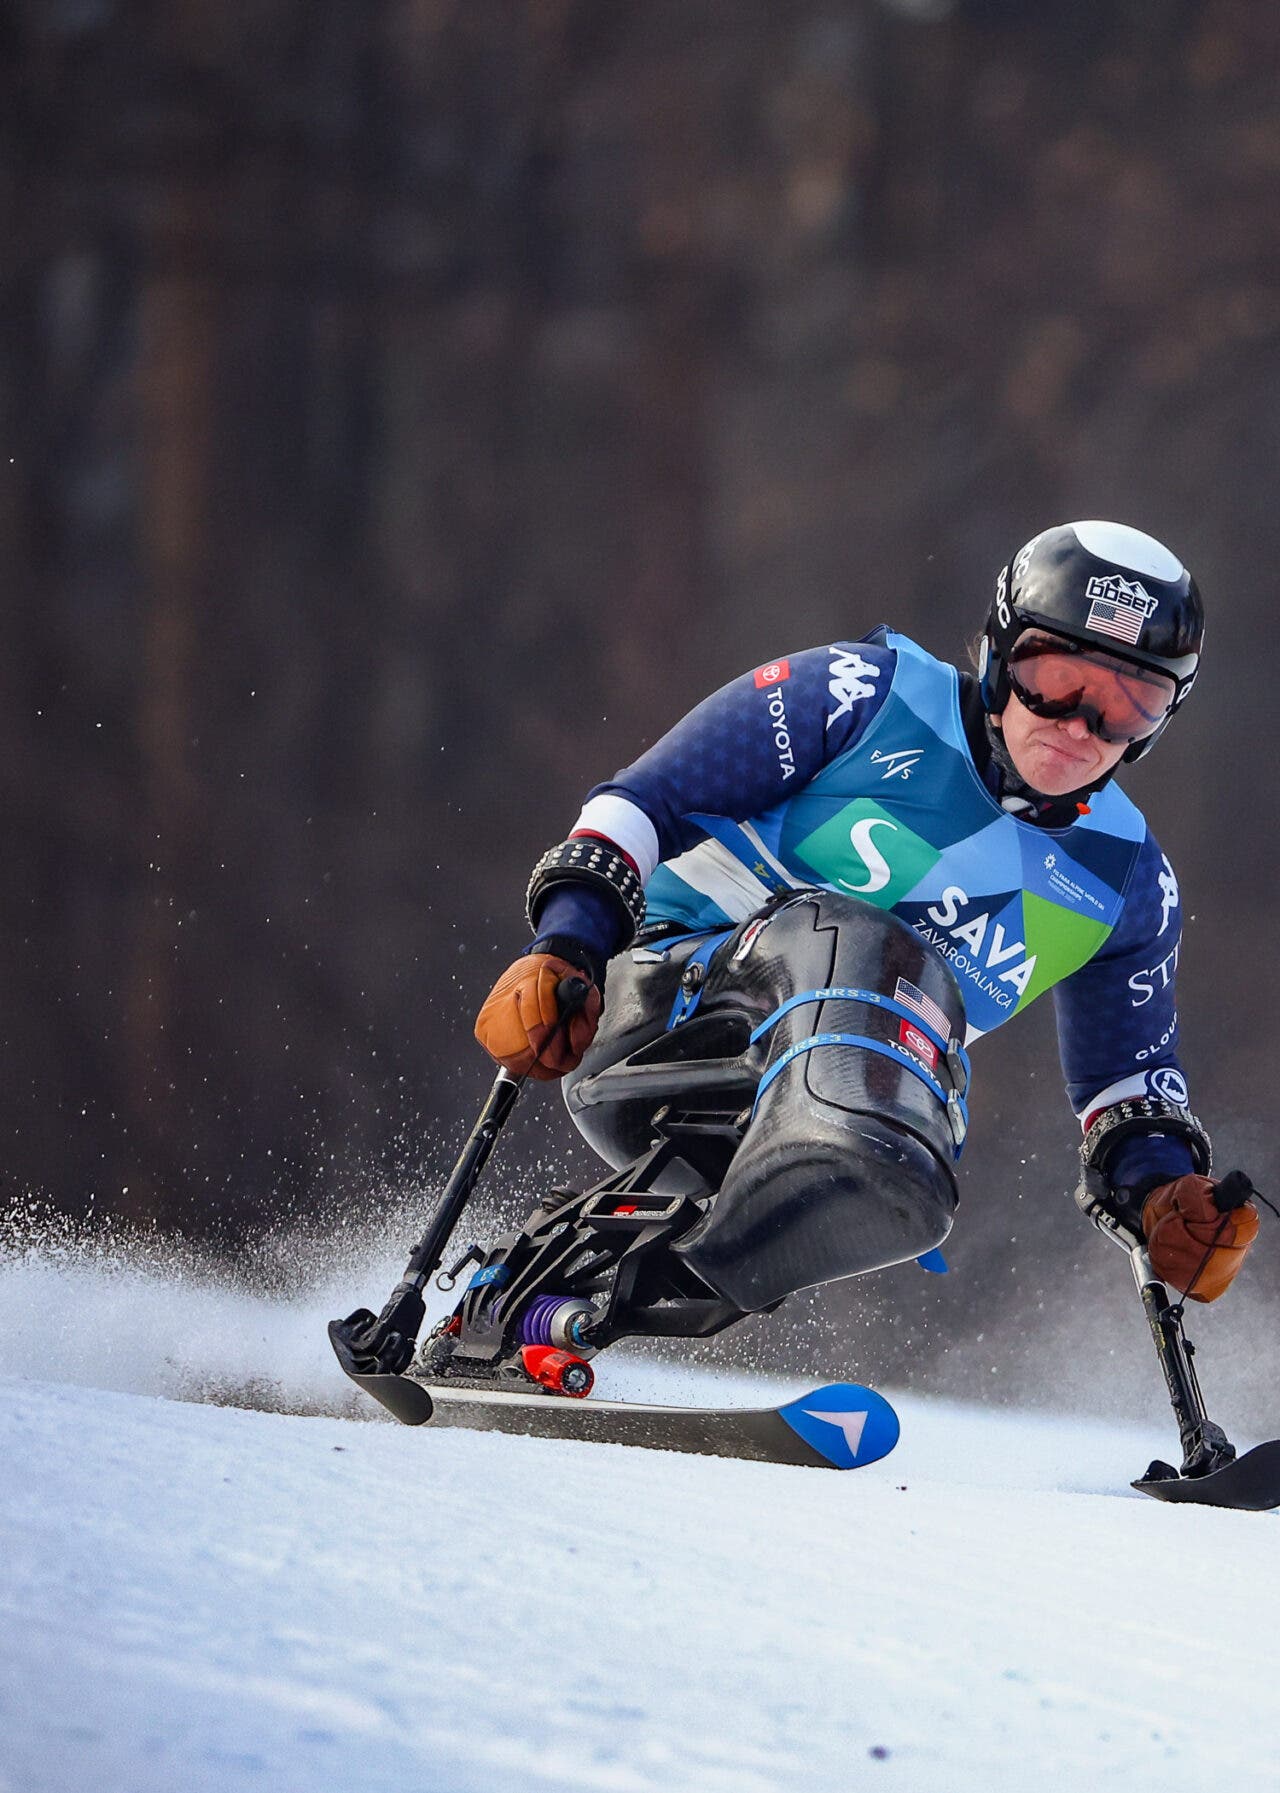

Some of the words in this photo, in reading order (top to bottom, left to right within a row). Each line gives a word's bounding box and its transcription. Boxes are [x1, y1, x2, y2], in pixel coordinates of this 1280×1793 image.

[997, 565, 1011, 629] POC
[767, 687, 796, 780] TOYOTA
[838, 817, 898, 893] S
[912, 918, 1014, 1009] ZAVAROVALNICA
[927, 886, 1038, 996] SAVA
[815, 987, 881, 1003] NRS-3
[782, 1034, 842, 1063] NRS-3
